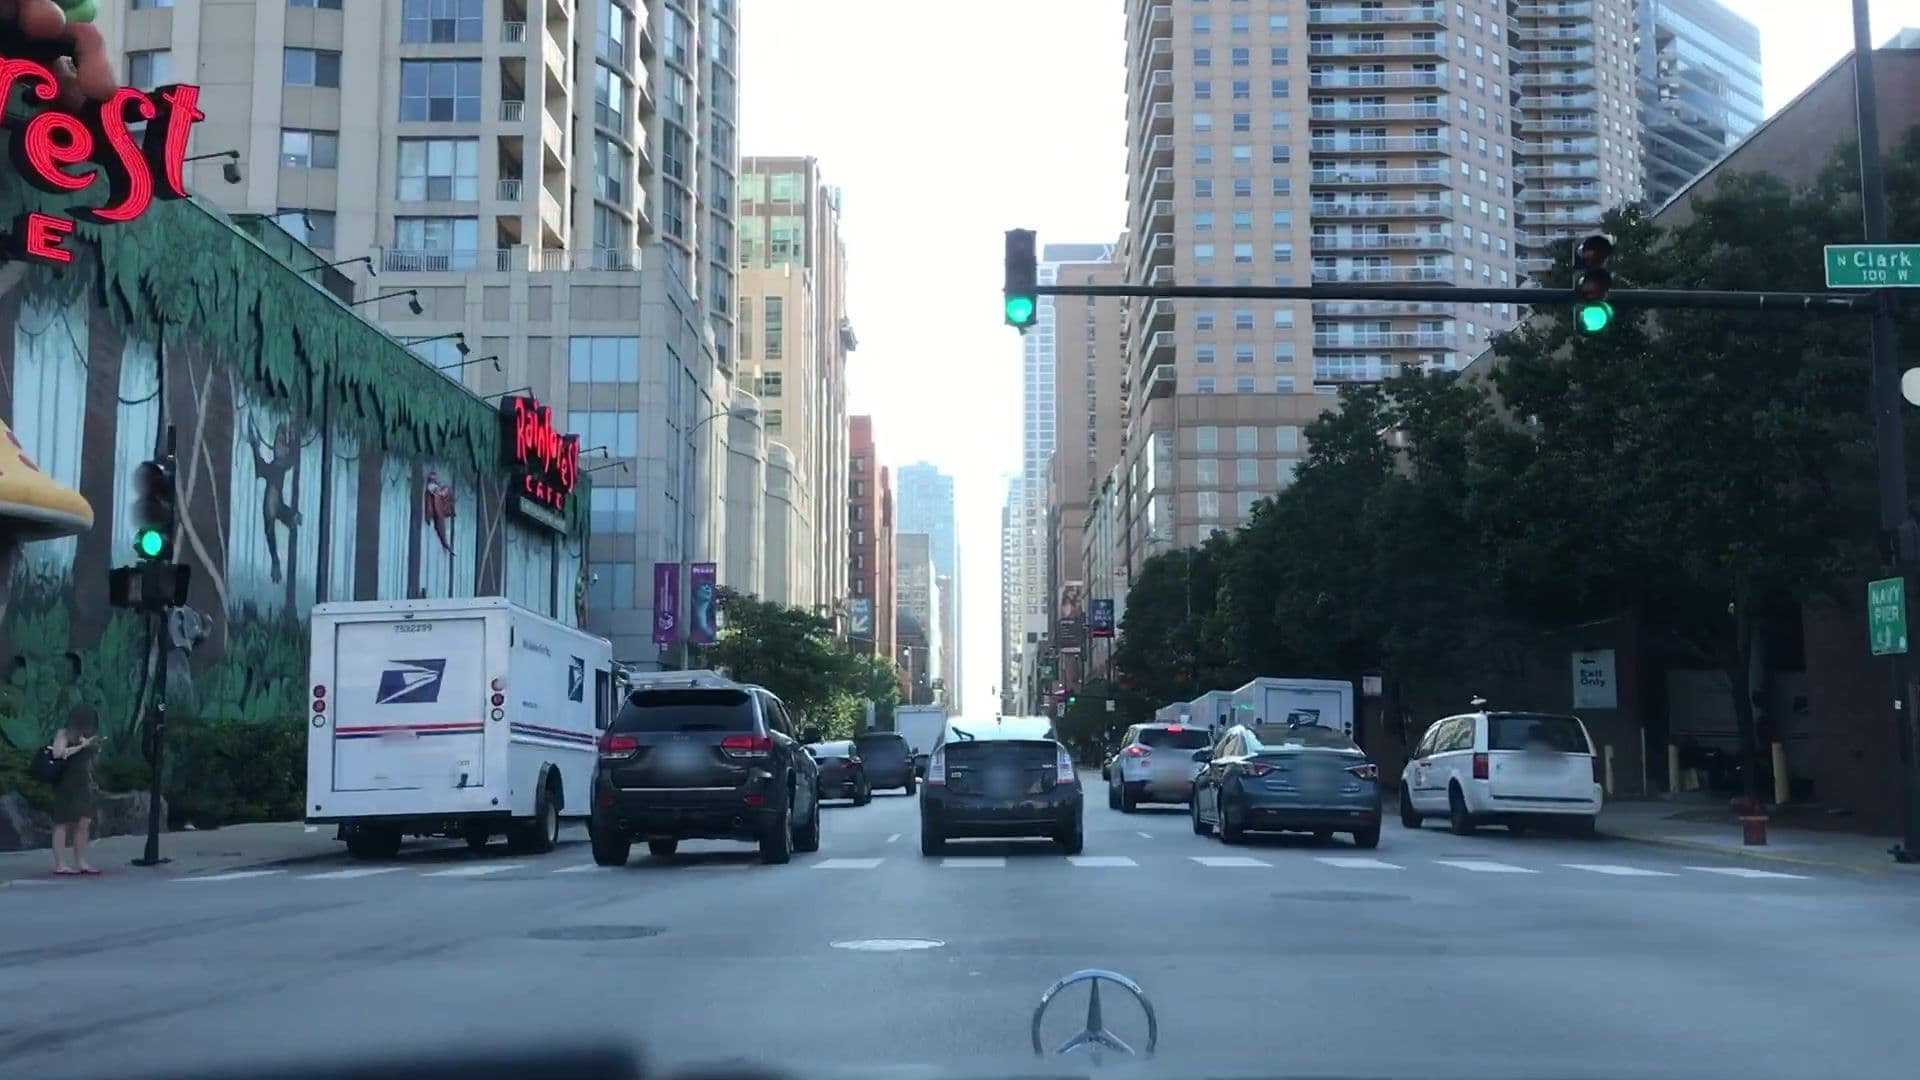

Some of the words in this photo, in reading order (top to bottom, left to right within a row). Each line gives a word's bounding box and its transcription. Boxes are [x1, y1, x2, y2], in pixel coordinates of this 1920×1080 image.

[1837, 255, 1847, 267] N
[1853, 250, 1912, 268] Clark
[1862, 269, 1887, 282] 100
[1898, 269, 1908, 281] W
[1872, 586, 1900, 605] NAVY
[1874, 606, 1900, 625] PIER
[1580, 669, 1603, 679] Exit
[1580, 679, 1606, 688] Only
